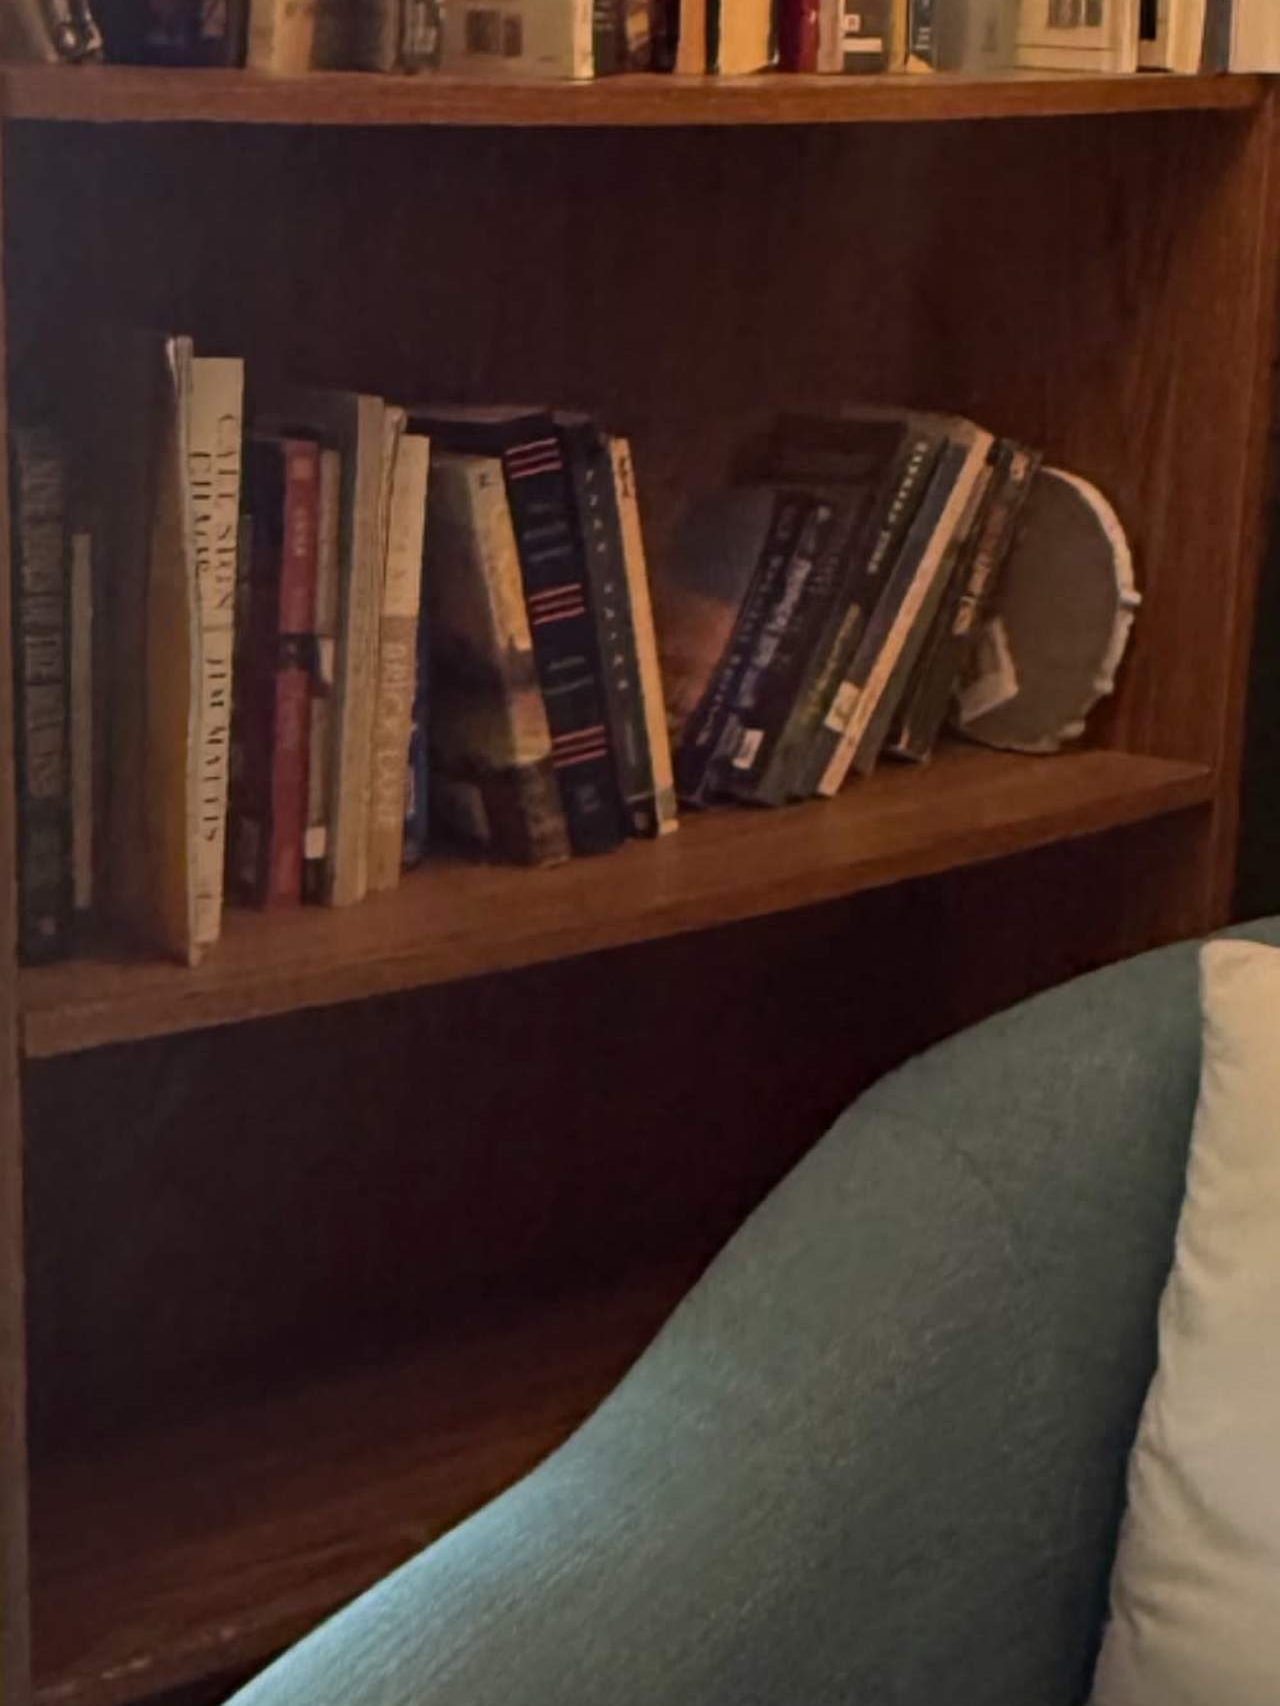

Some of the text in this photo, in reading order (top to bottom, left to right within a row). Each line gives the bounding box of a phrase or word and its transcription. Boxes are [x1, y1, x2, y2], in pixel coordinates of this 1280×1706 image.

[210, 411, 239, 625] CALL SIGN
[200, 656, 227, 844] JIM MATTIS
